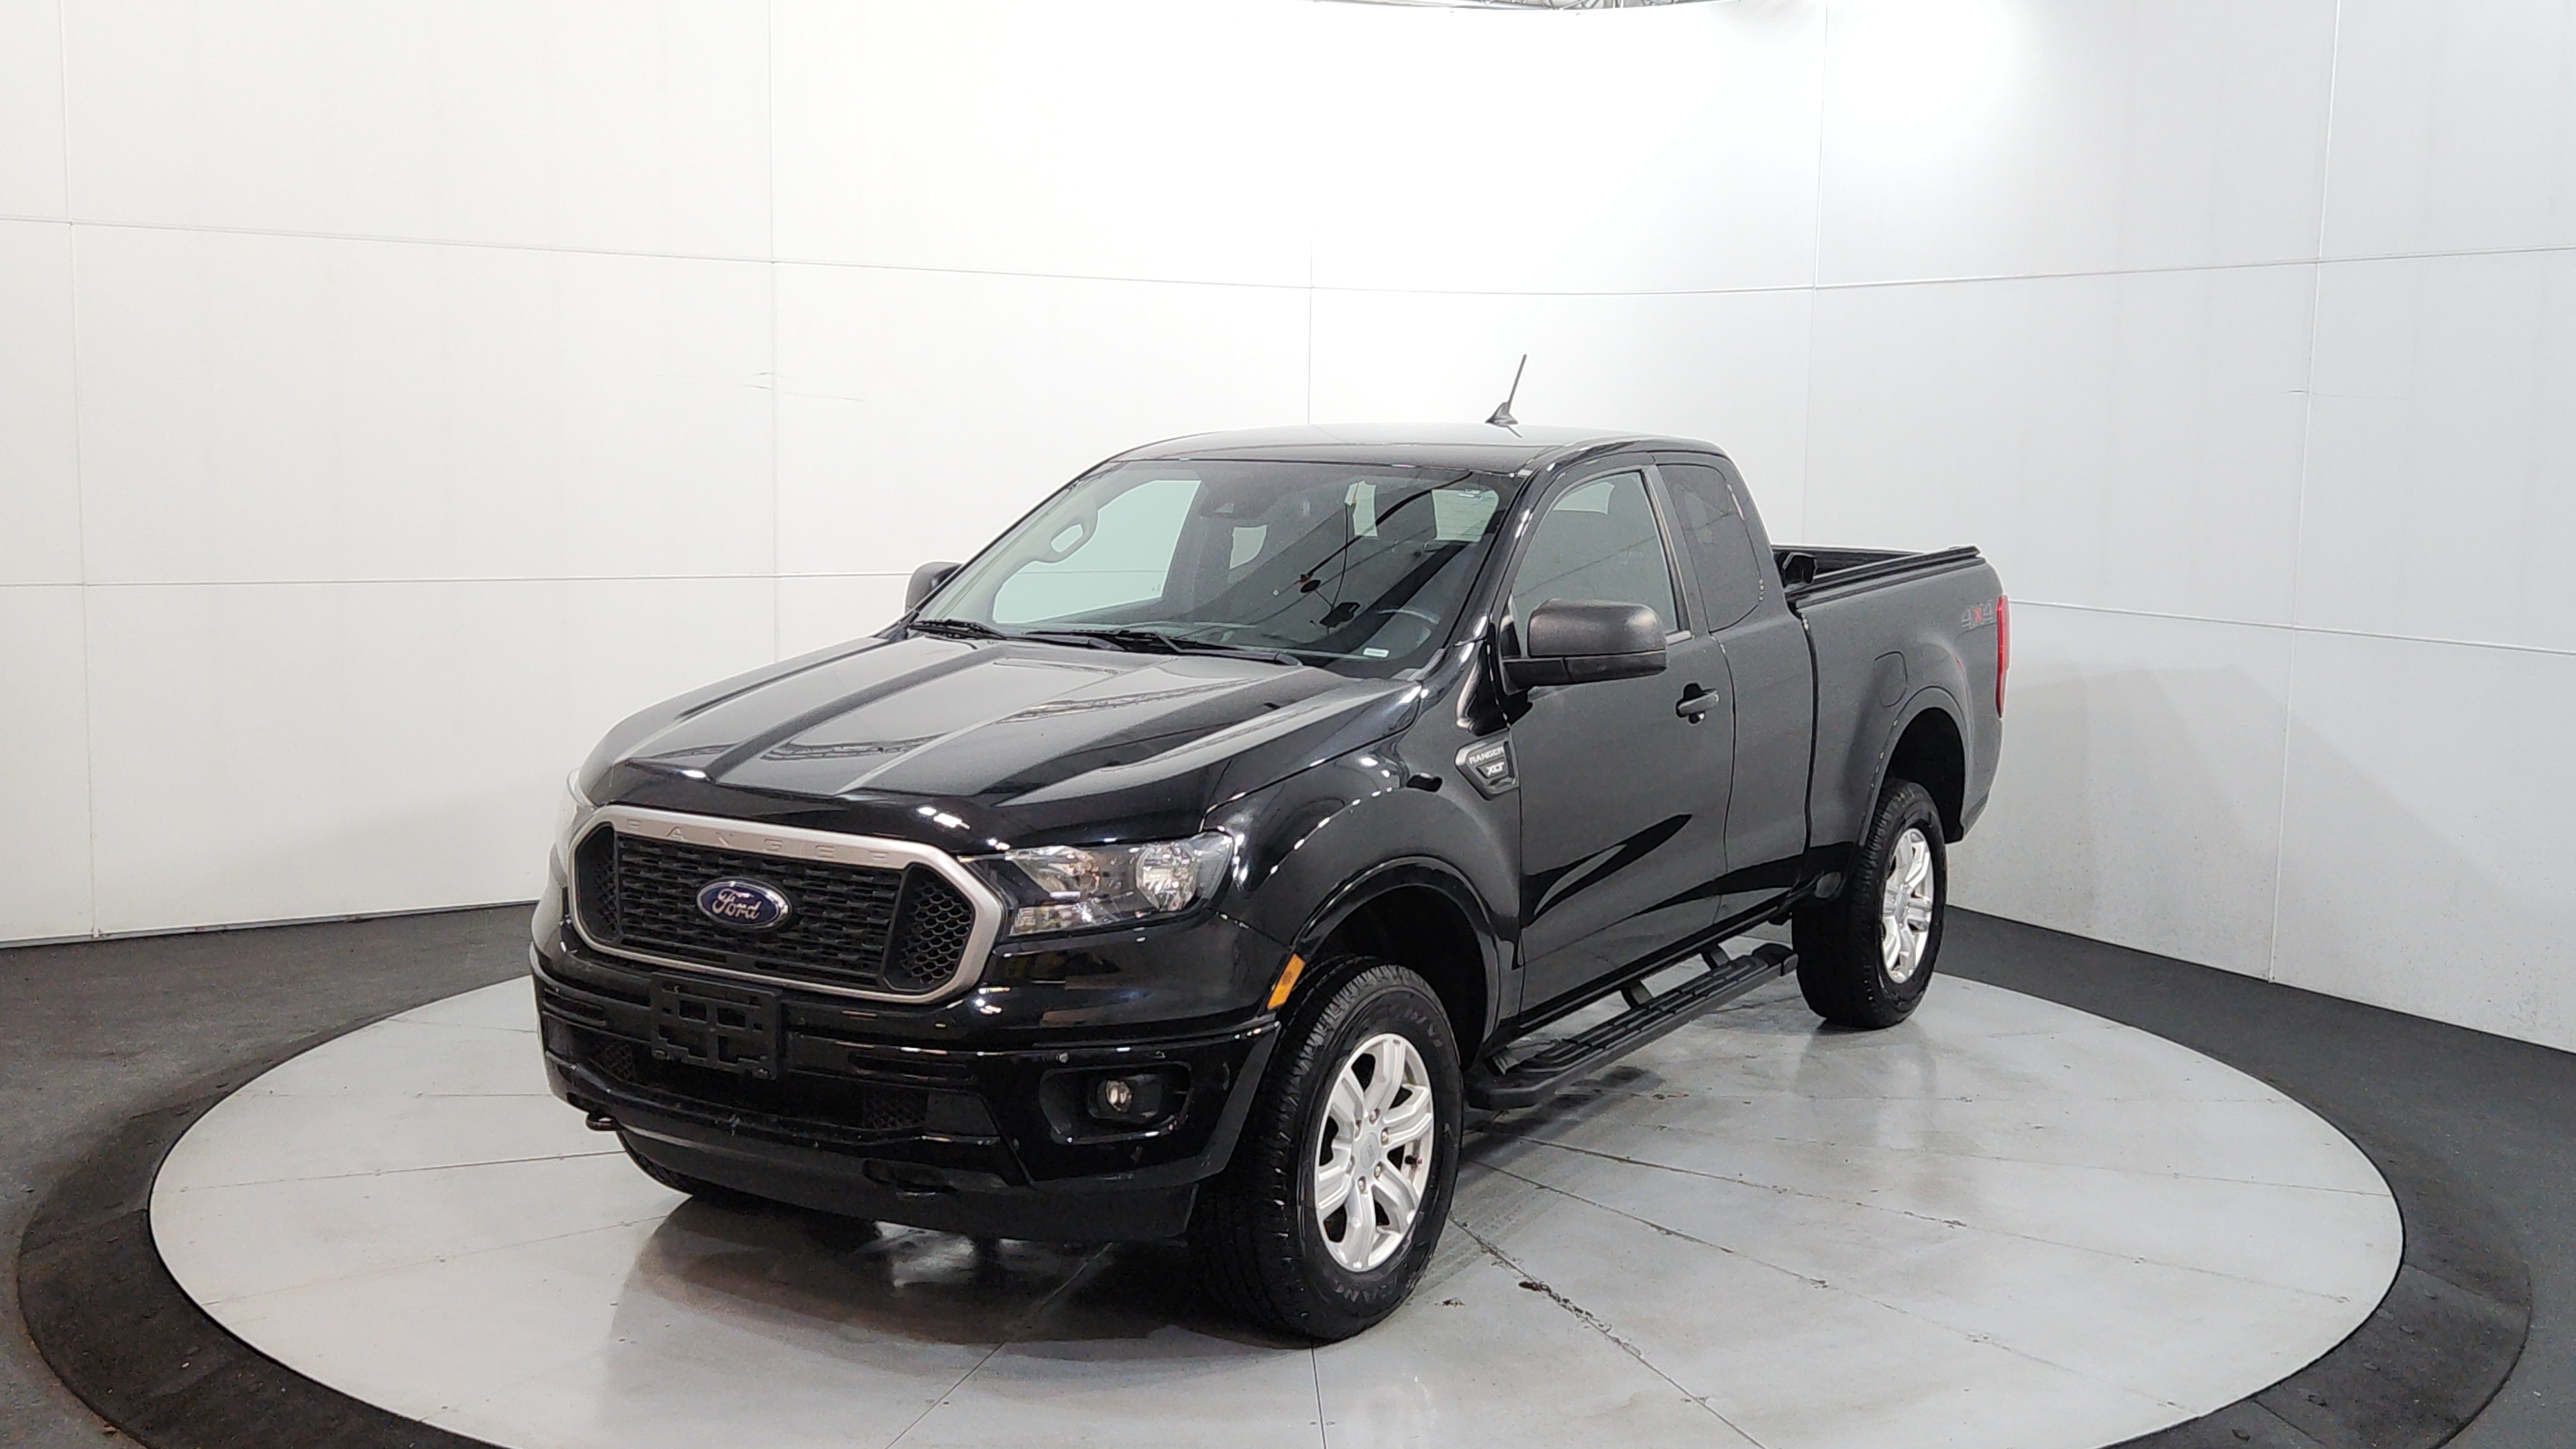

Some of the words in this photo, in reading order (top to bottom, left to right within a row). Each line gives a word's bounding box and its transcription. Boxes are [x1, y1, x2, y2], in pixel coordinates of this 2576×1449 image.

[1468, 746, 1505, 765] RANGER
[1485, 761, 1505, 776] XLT
[712, 888, 762, 920] Ford
